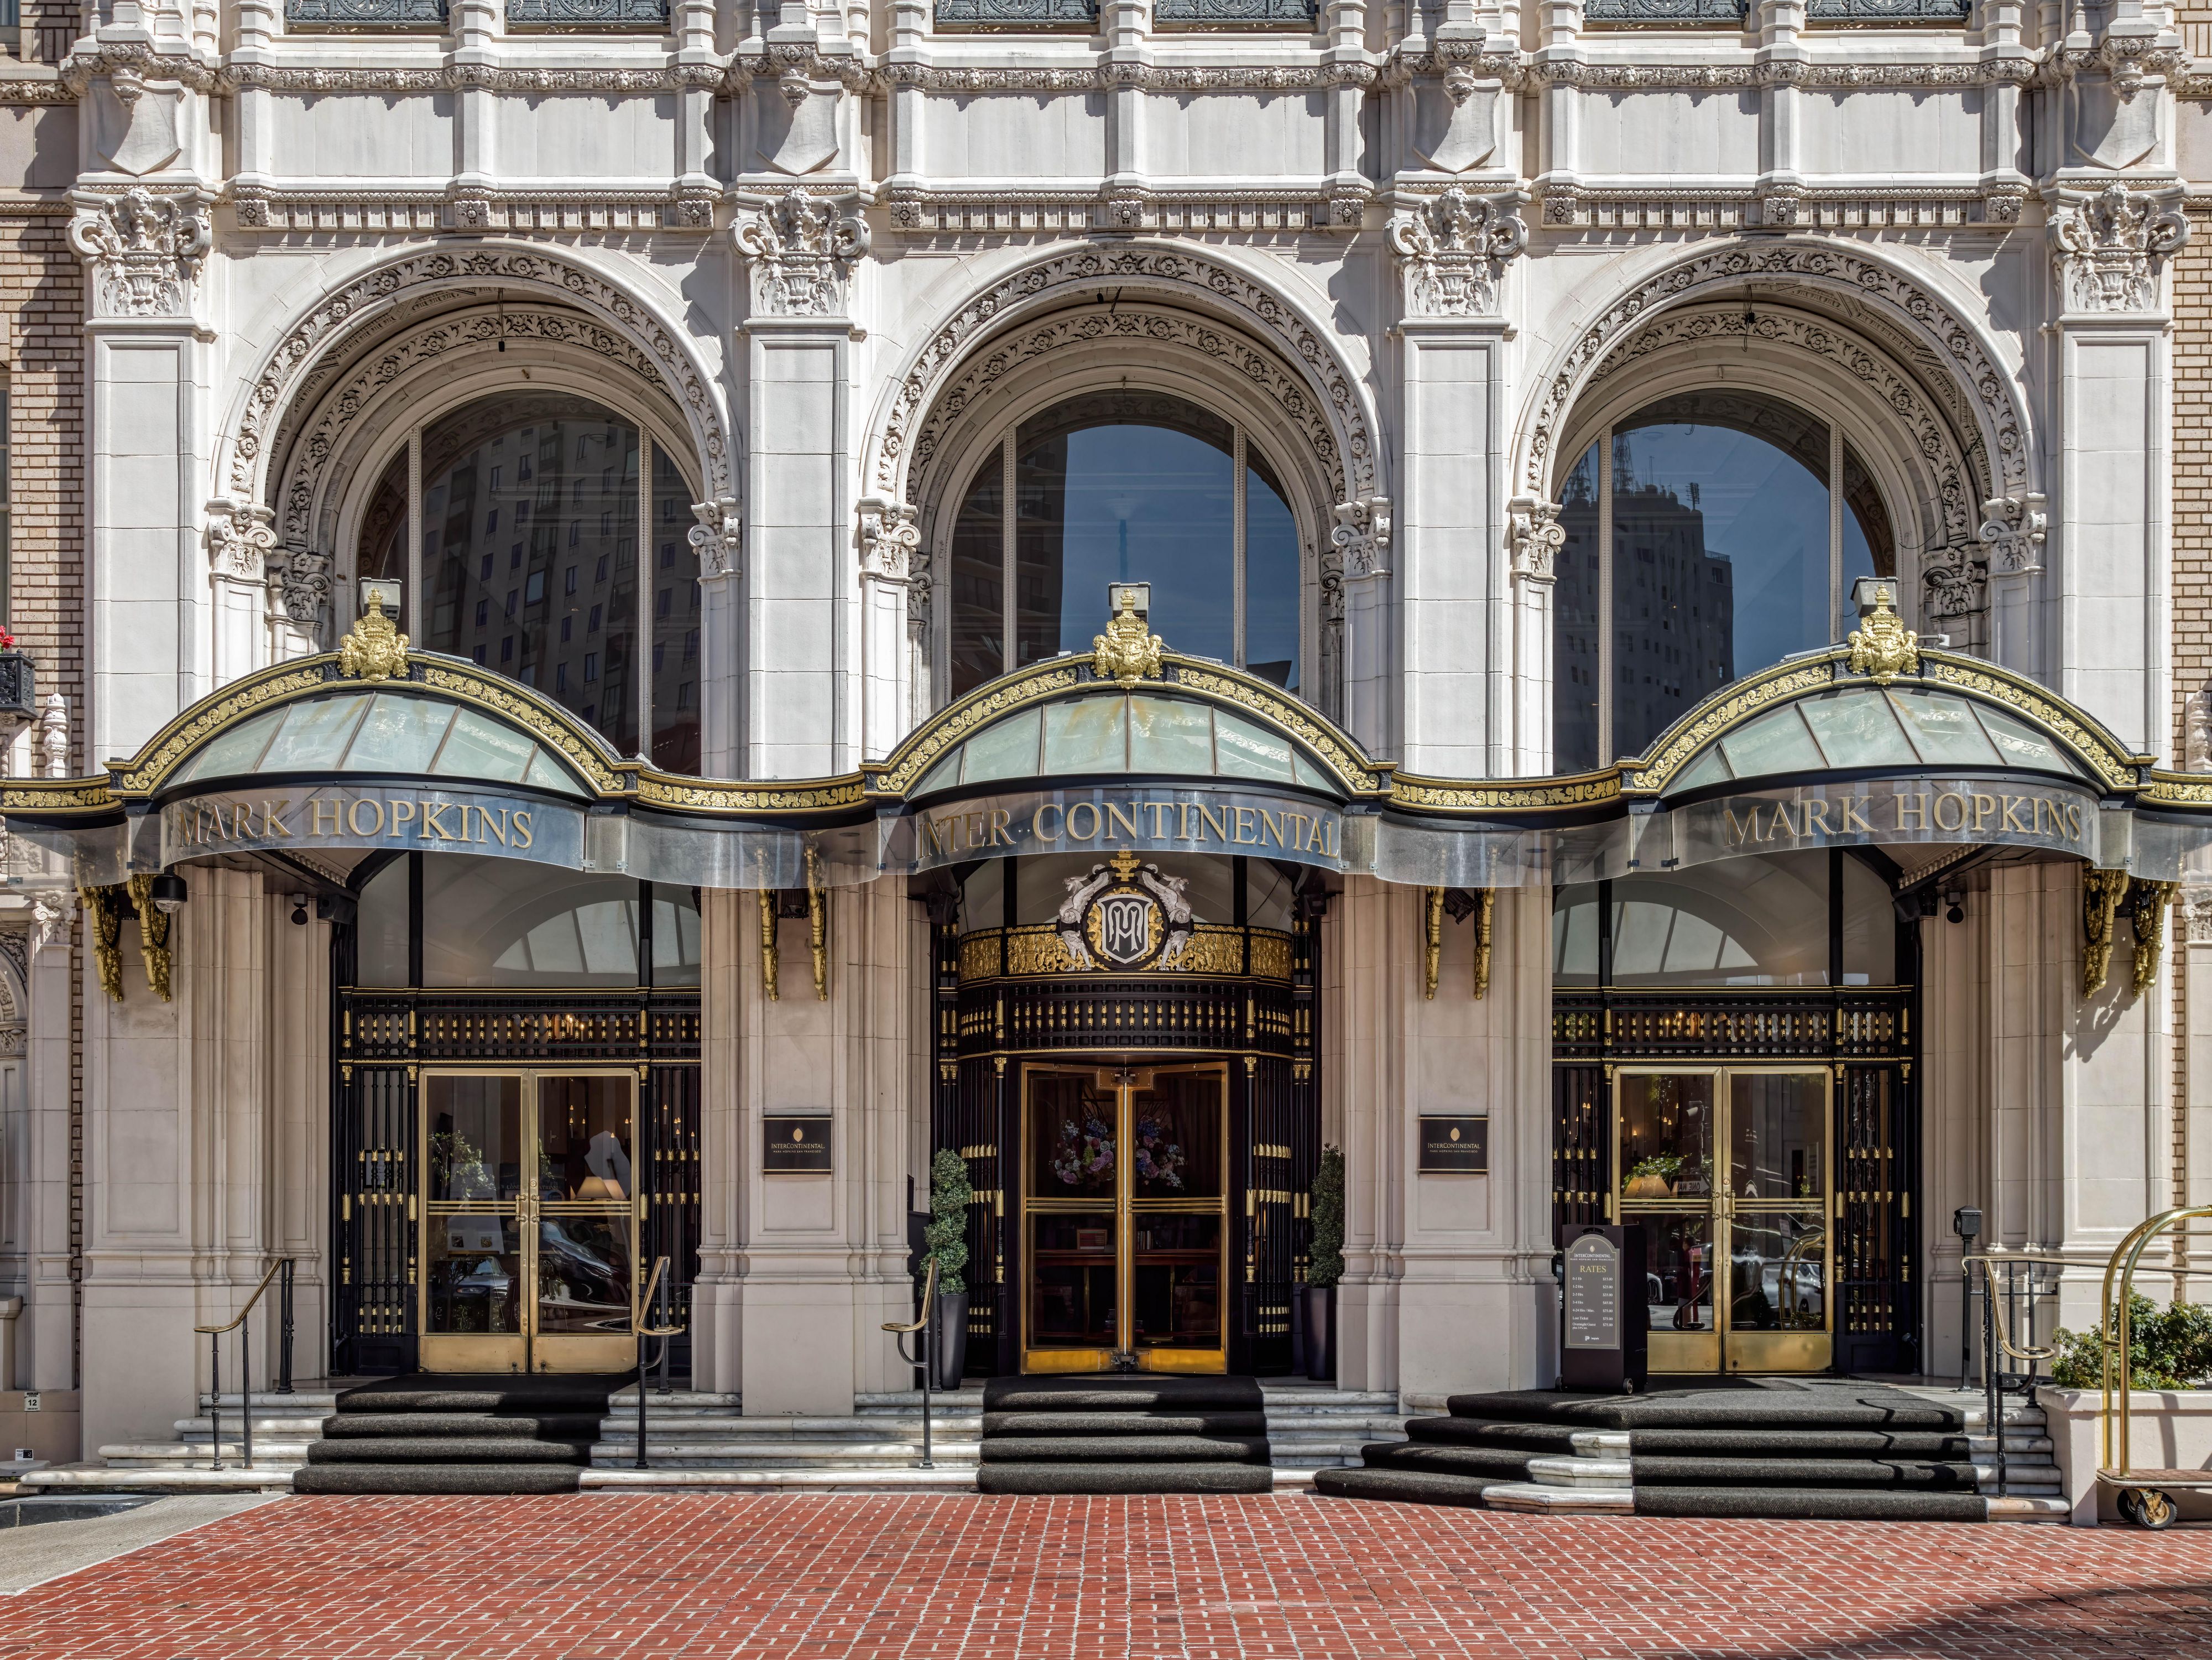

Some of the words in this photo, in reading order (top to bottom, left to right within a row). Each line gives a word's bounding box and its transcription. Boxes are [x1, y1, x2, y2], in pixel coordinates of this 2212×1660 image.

[178, 800, 295, 849] MARK
[307, 798, 534, 849] HOPKINS
[919, 809, 1017, 859] INTER
[1032, 802, 1339, 858] CONTINENTAL
[1723, 795, 1879, 846] MARK
[1892, 793, 2081, 842] HOPKINS
